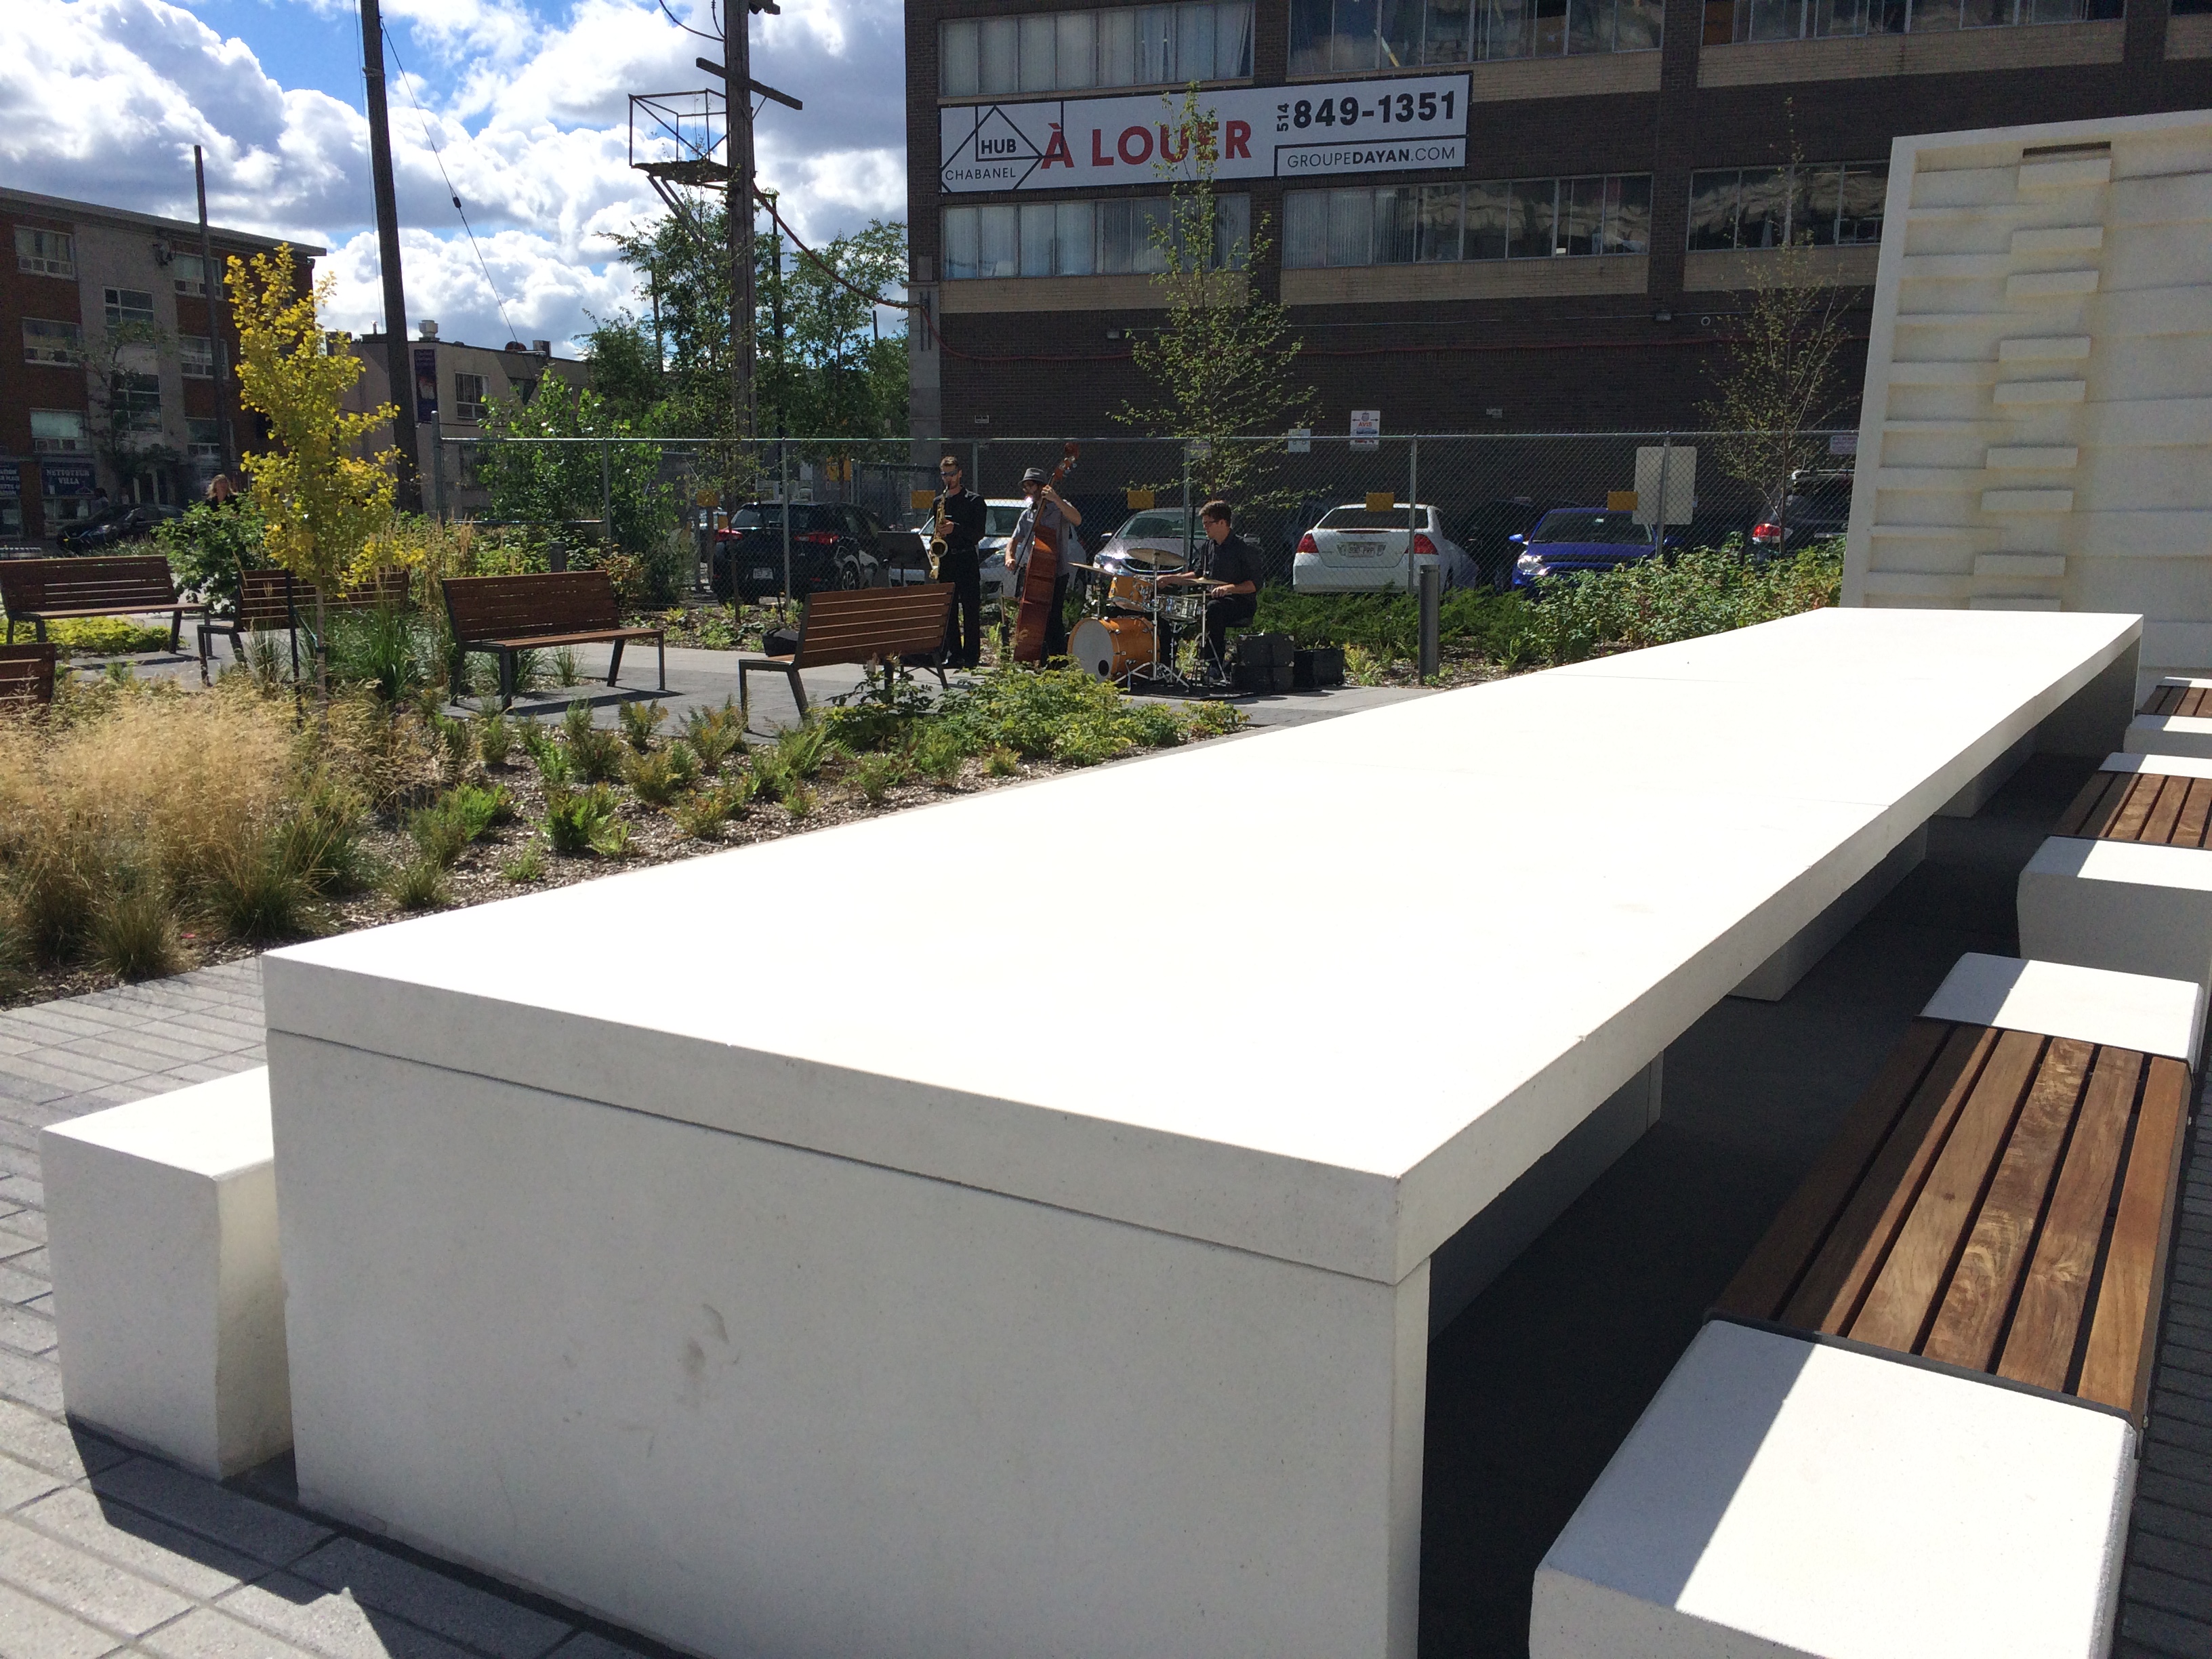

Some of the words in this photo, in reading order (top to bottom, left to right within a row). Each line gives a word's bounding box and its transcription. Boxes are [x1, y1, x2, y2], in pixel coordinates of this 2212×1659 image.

[1277, 103, 1289, 131] 514
[1293, 91, 1455, 129] 849-1351
[981, 138, 1017, 155] HUB
[1040, 122, 1076, 169] À
[1092, 120, 1252, 167] LOUER
[1287, 146, 1455, 168] GROUPEDAYAN.COM
[945, 167, 1017, 181] CHABANEL
